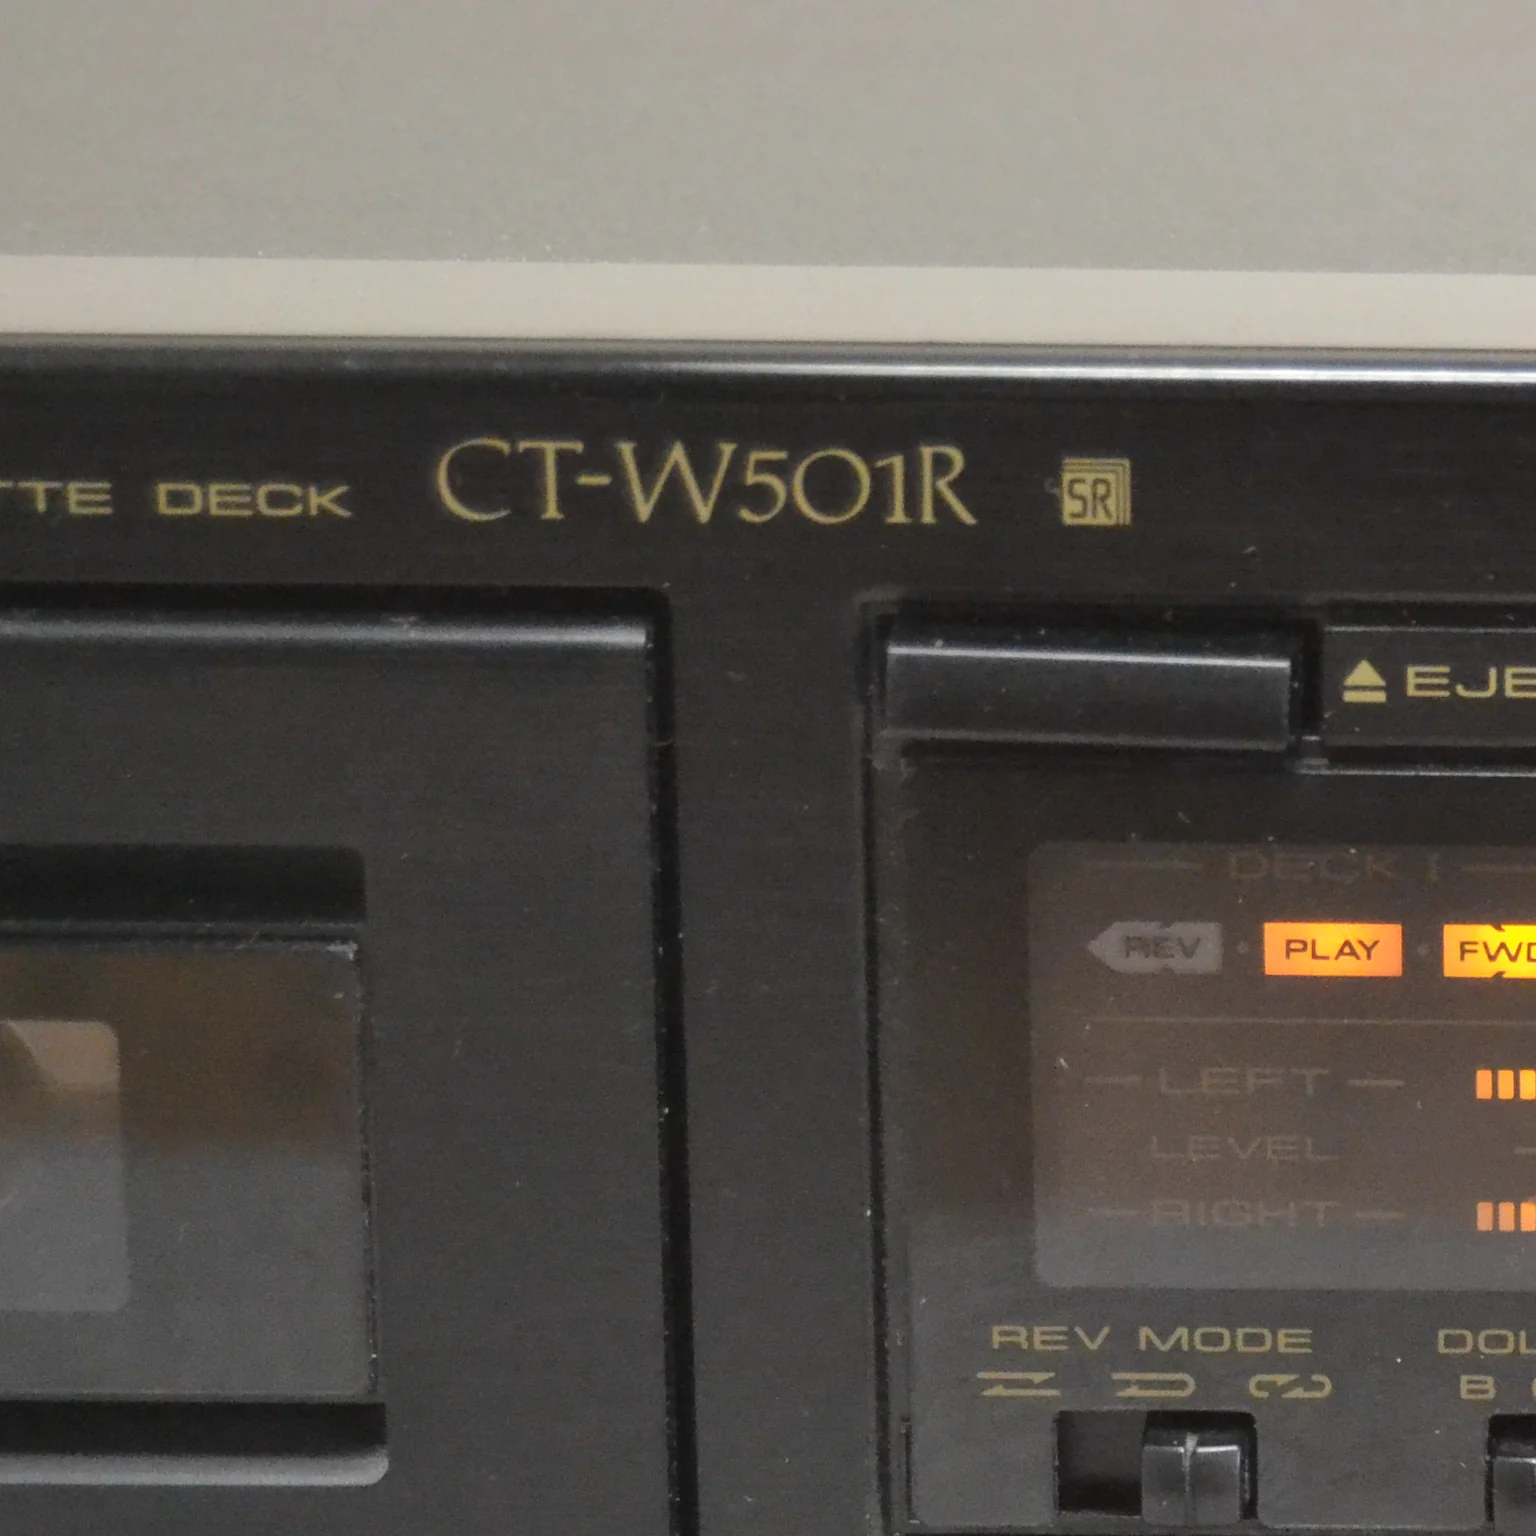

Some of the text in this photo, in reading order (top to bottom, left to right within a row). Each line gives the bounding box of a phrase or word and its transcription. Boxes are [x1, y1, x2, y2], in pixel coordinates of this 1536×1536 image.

[437, 438, 976, 525] CT-W501R
[0, 480, 351, 517] TE DECK
[1229, 851, 1403, 880] DECK
[1124, 936, 1202, 959] REV
[1285, 939, 1379, 960] PLAY
[1158, 1066, 1331, 1097] LEFT
[1150, 1134, 1339, 1162] LEVEL
[1150, 1198, 1341, 1228] RIGHT
[992, 1325, 1311, 1353] REV MODE
[1460, 1375, 1495, 1399] B
